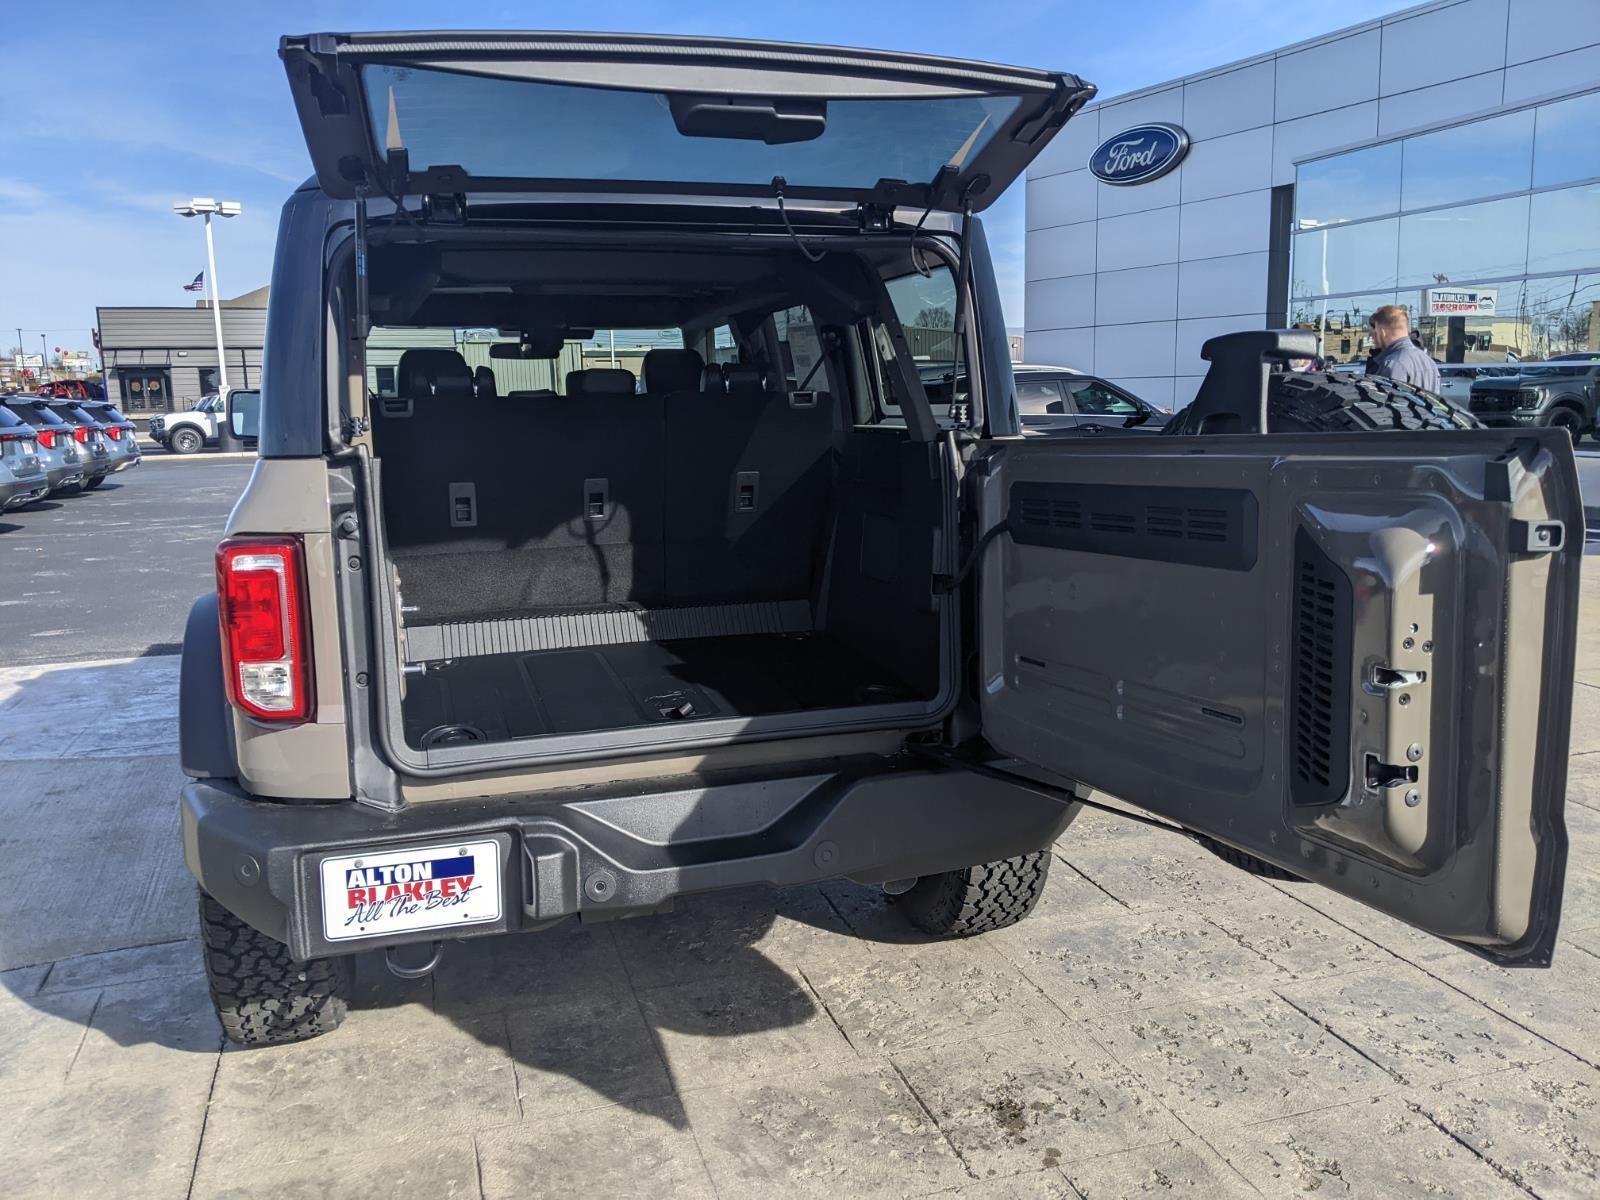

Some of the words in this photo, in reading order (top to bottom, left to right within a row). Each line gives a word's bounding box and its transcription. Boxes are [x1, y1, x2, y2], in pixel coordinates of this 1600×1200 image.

[1104, 137, 1158, 175] Ford
[347, 862, 432, 888] ALTON
[344, 902, 382, 926] All
[386, 893, 421, 918] The
[424, 885, 482, 911] Best
